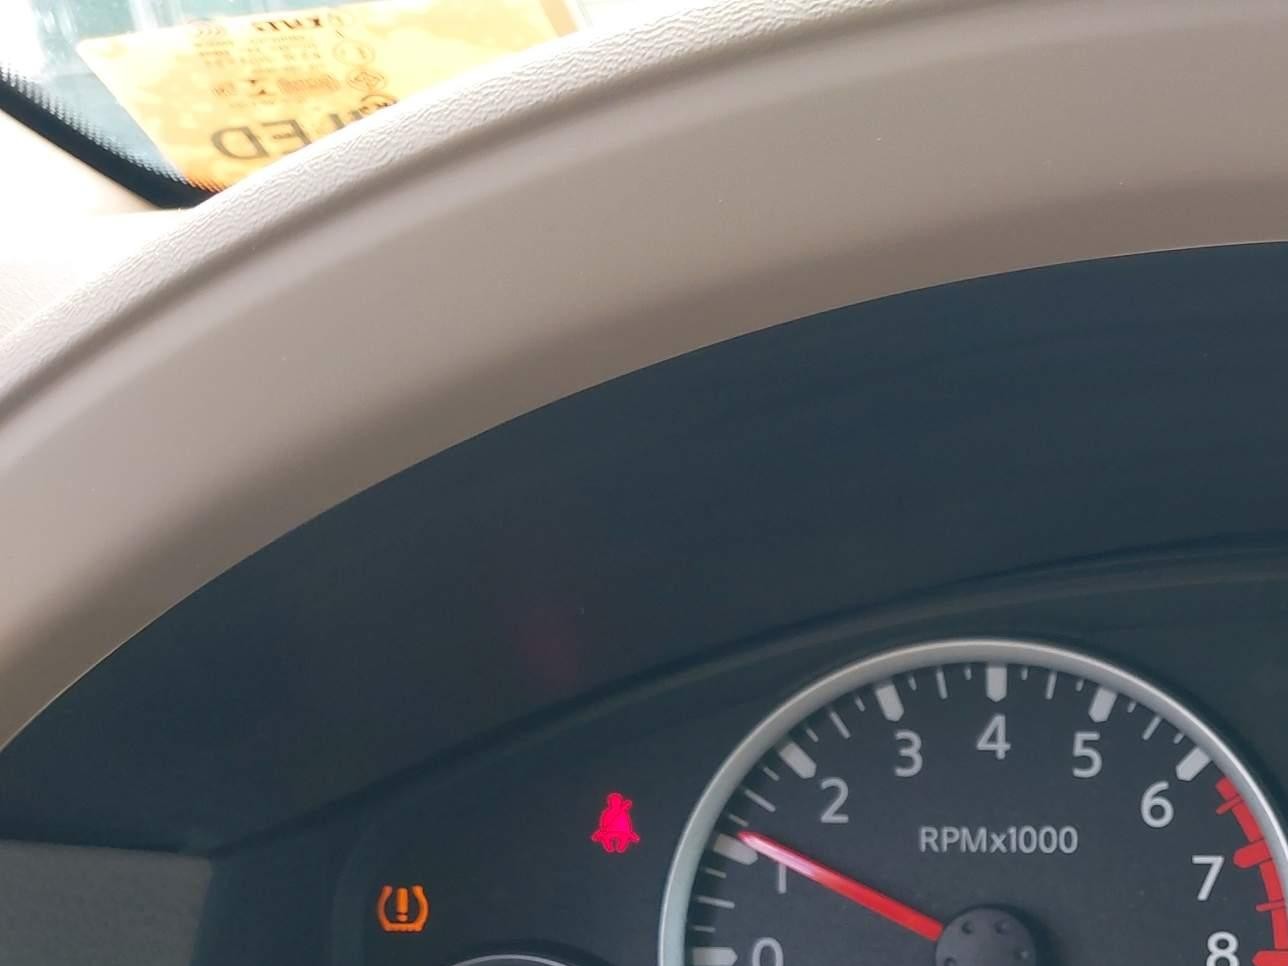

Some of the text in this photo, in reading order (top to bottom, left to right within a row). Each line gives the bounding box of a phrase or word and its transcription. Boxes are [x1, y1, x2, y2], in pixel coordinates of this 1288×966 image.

[895, 731, 923, 777] 3
[976, 714, 1011, 760] 4
[1073, 732, 1102, 778] 5
[820, 777, 849, 824] 2
[1141, 781, 1174, 828] 6
[919, 825, 1079, 854] RPMx1000
[1192, 855, 1225, 901] 7
